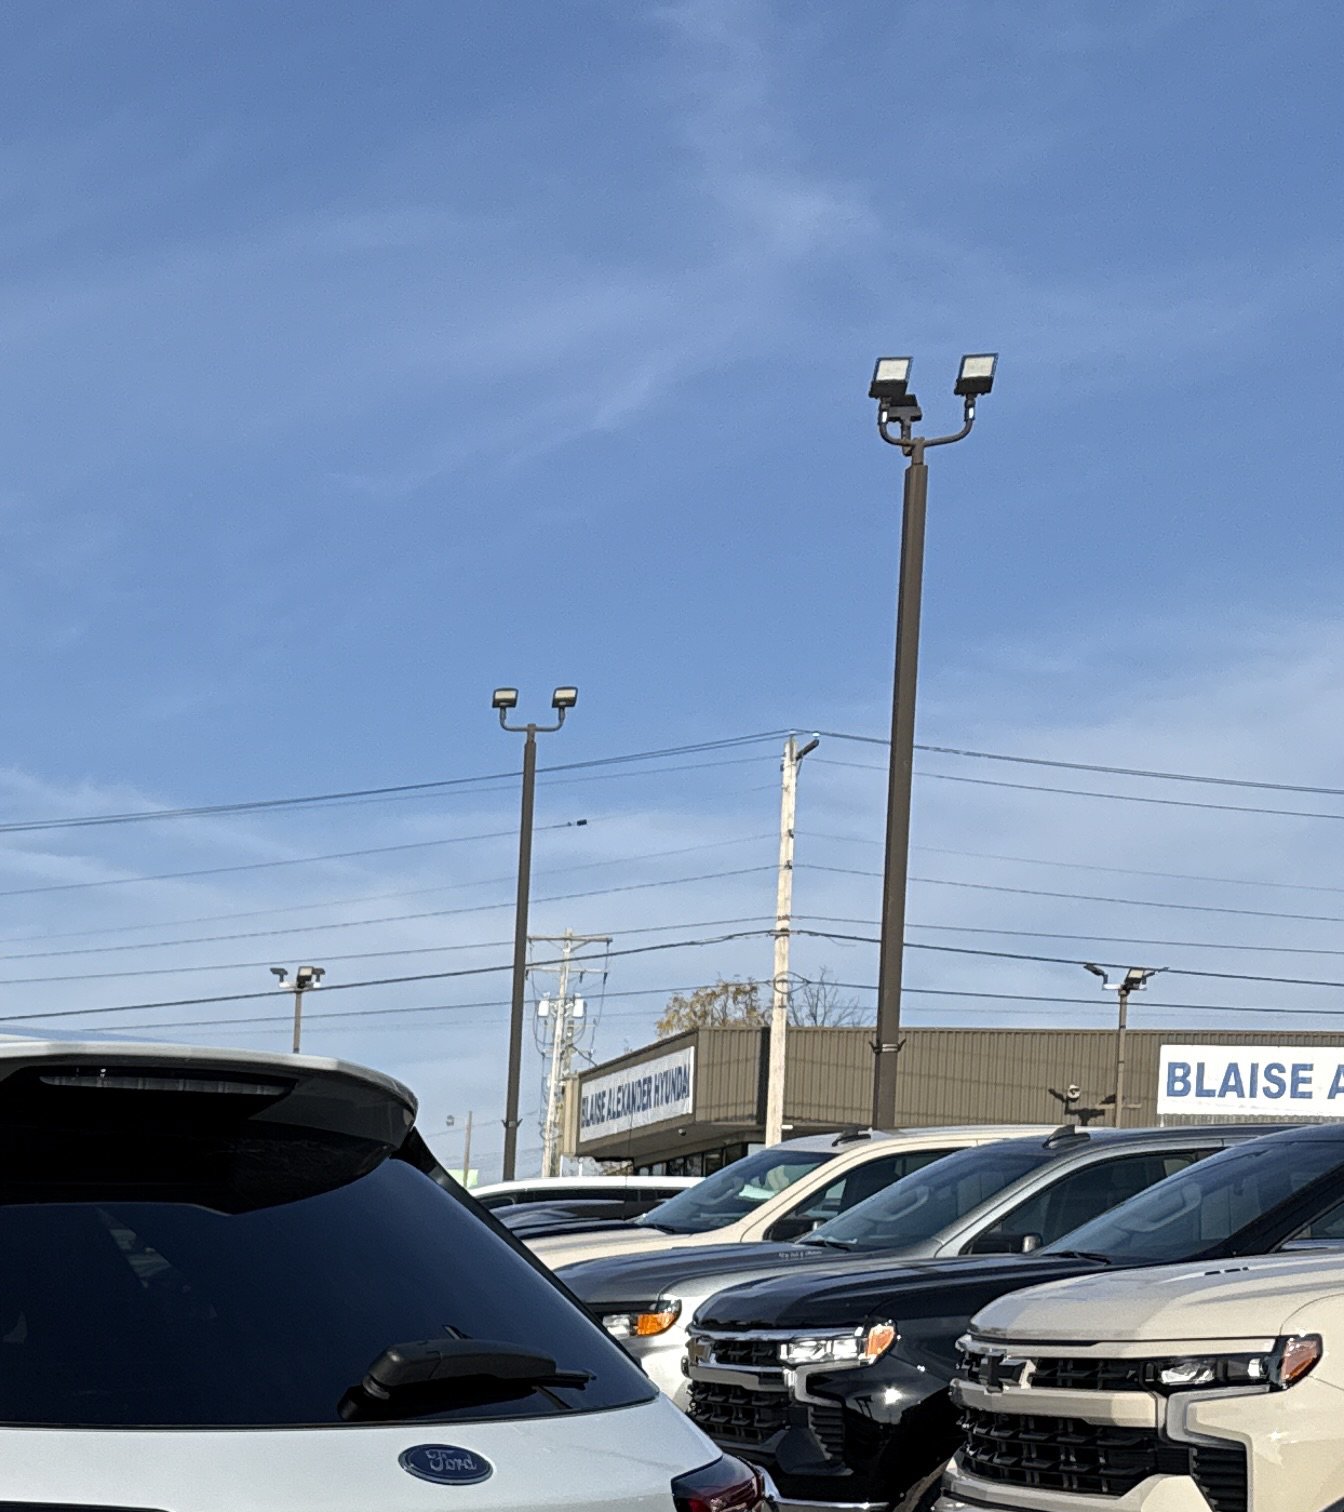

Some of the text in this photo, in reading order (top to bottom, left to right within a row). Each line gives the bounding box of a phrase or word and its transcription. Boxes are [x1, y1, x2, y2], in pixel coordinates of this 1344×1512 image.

[581, 1063, 690, 1128] BLAISE ALEXANDER HYUNDAI
[1166, 1062, 1314, 1099] BLAISE
[425, 1448, 479, 1473] Ford
